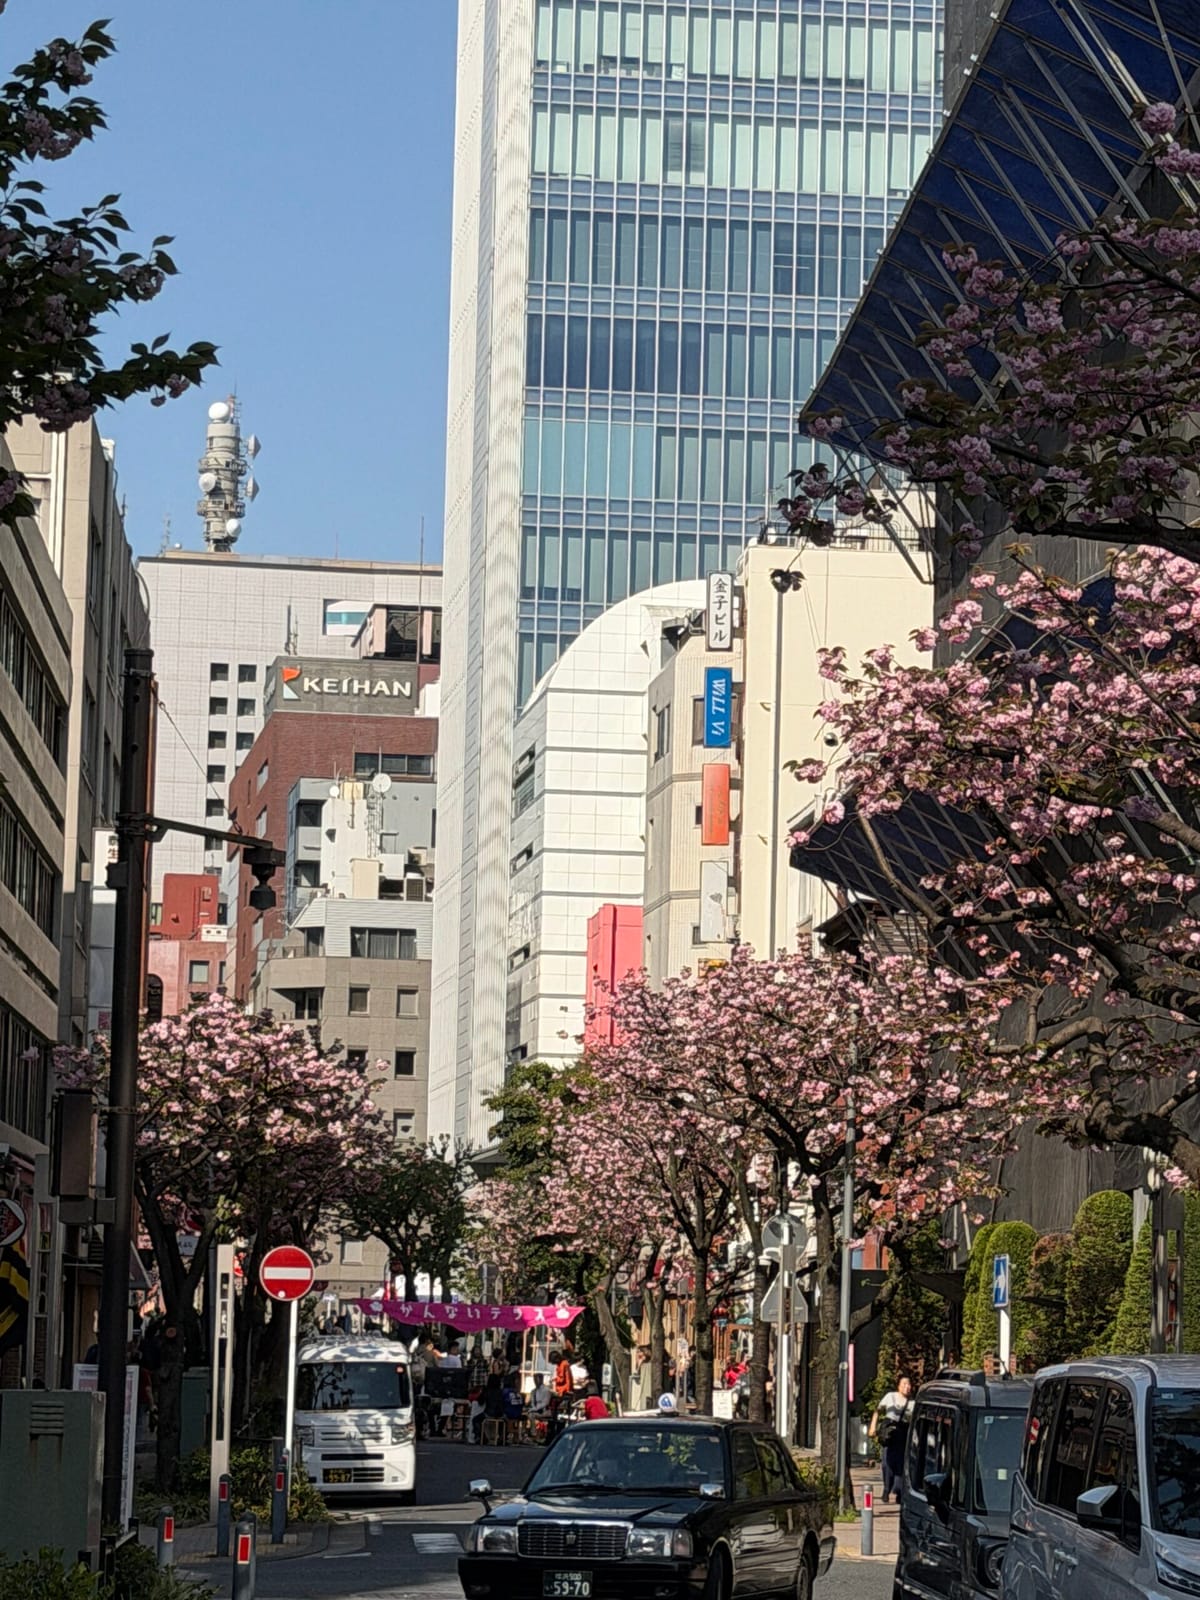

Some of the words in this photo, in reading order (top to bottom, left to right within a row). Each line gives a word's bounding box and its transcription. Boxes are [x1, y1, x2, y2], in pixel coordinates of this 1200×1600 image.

[712, 577, 728, 641] 金子ビル
[303, 677, 411, 697] KEIHAN
[400, 1303, 545, 1322] かんないテラス
[553, 1581, 590, 1596] 59-70
